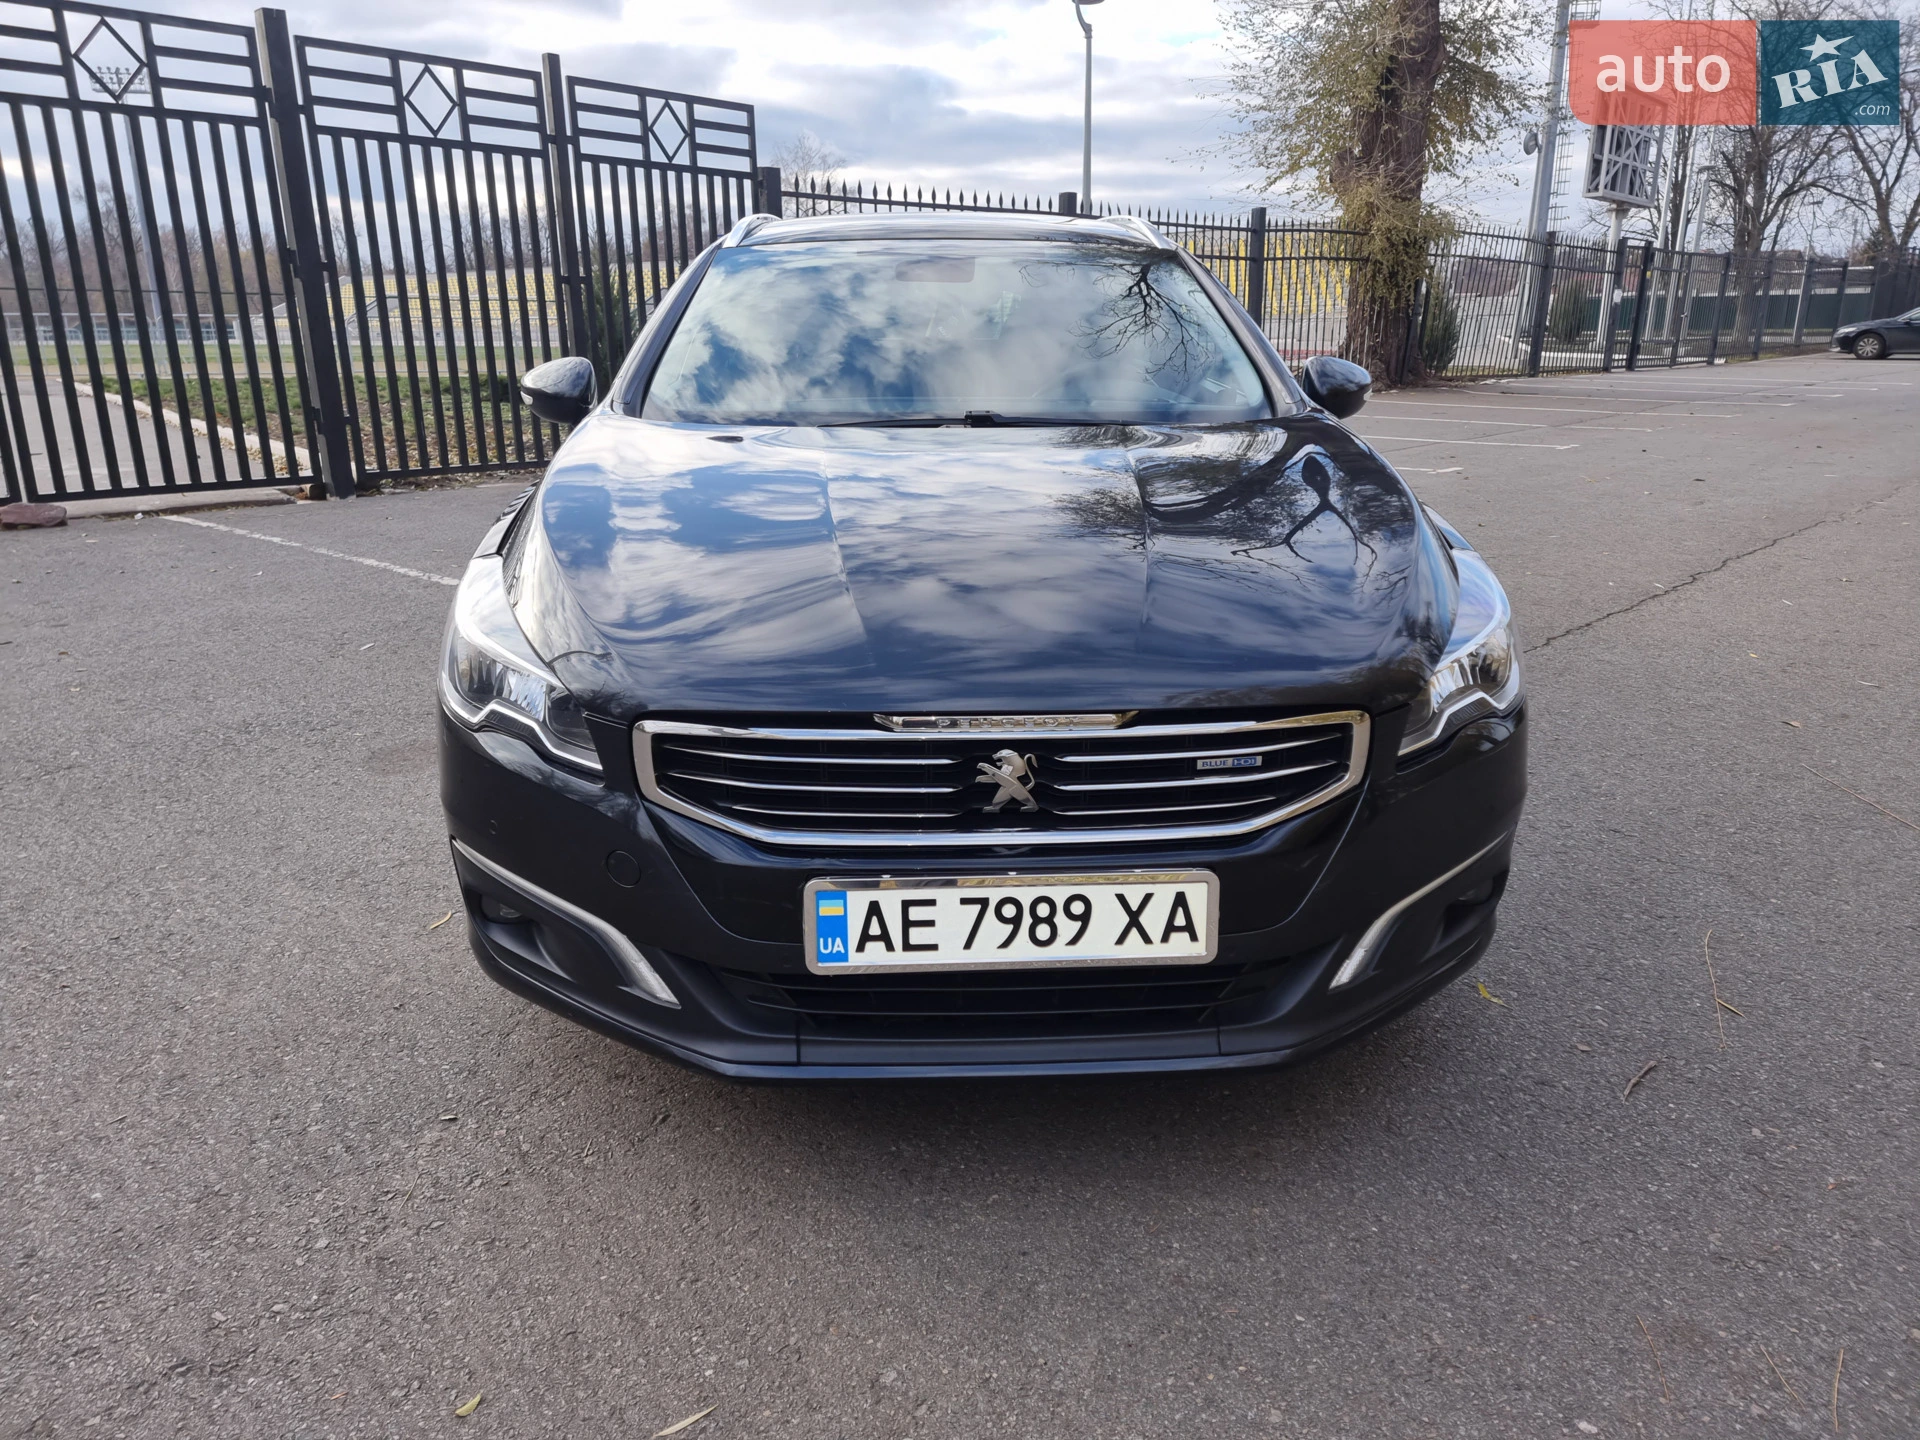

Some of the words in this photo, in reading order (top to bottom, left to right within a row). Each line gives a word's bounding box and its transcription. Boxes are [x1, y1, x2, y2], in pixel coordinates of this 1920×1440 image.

[1201, 760, 1228, 768] BLUE
[855, 898, 939, 953] AE
[959, 894, 1093, 950] 7989
[1114, 891, 1199, 946] XA
[819, 937, 845, 954] UA
